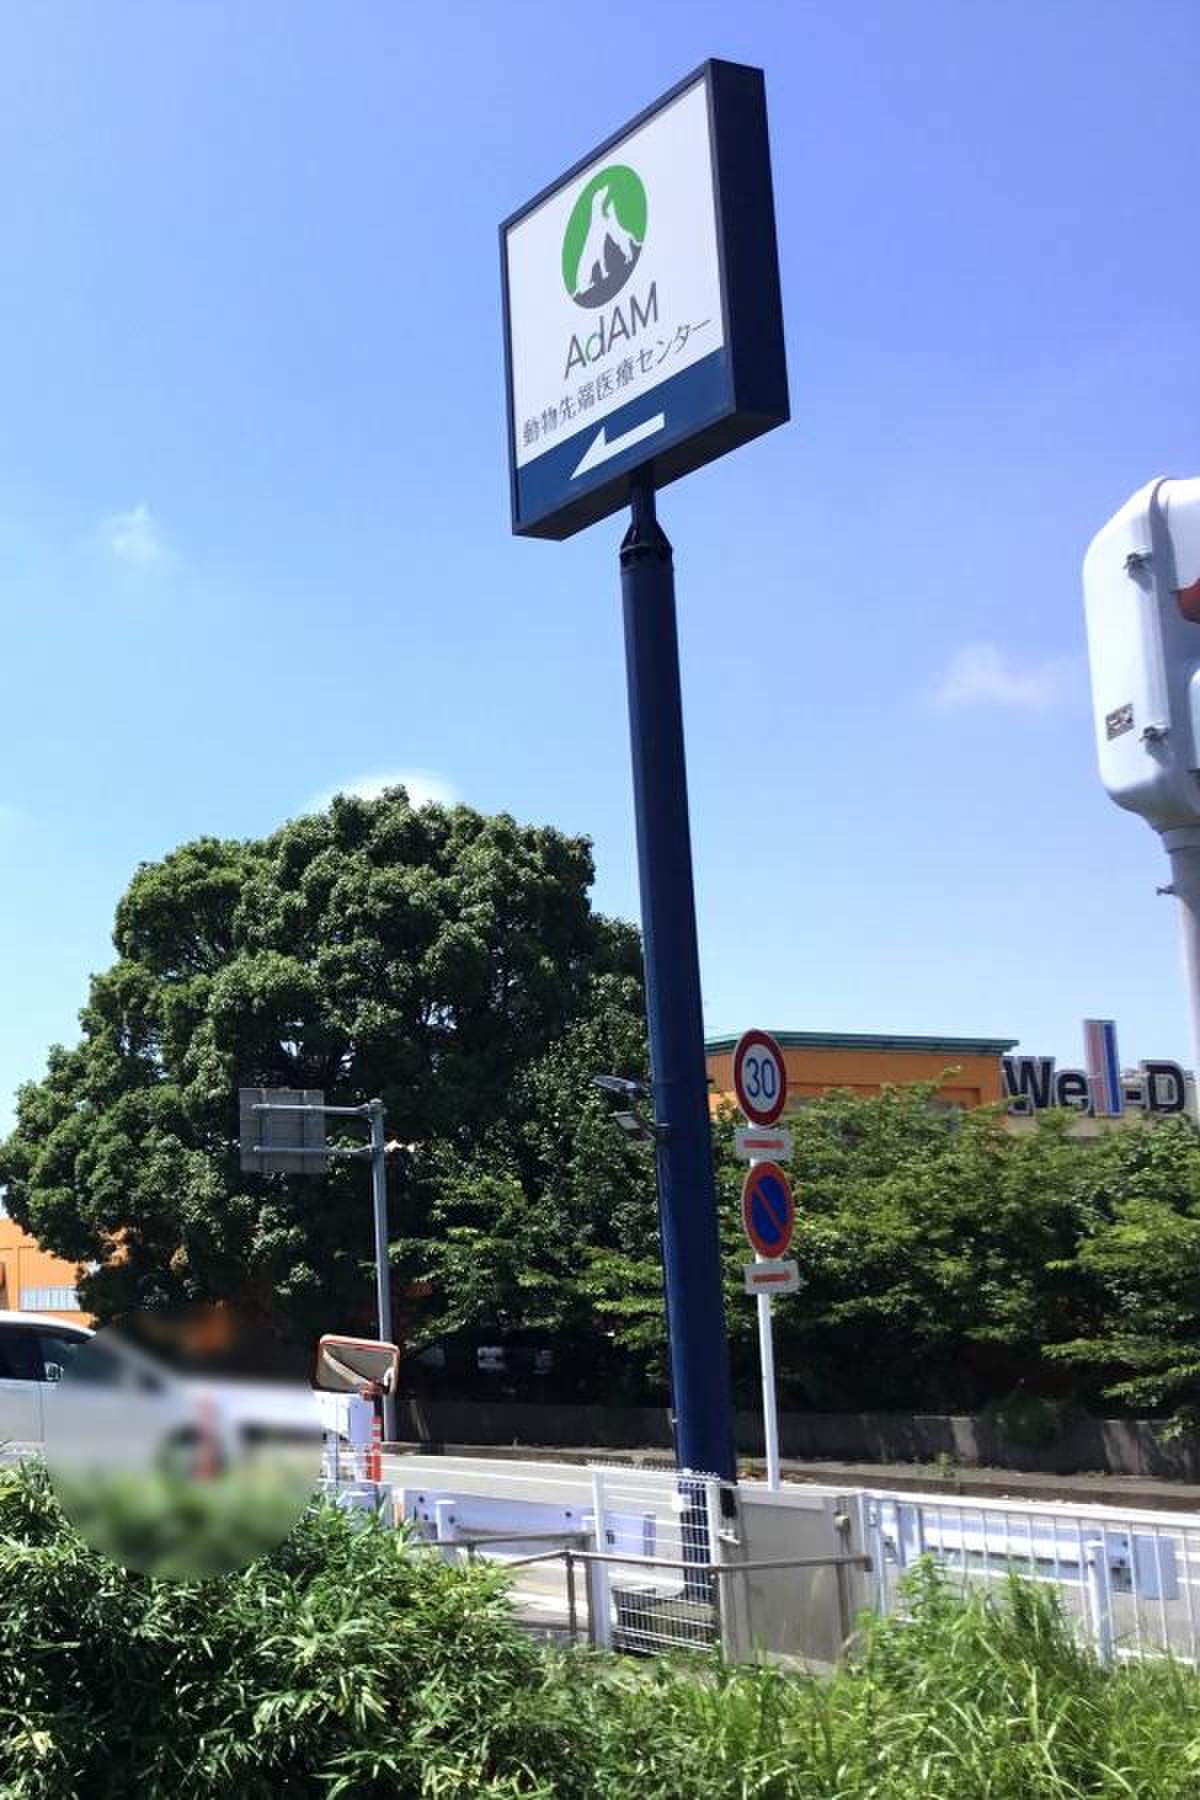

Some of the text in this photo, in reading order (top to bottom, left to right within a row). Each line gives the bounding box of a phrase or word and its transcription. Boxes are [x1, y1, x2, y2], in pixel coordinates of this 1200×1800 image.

[564, 280, 658, 379] AdAM
[522, 319, 711, 447] 動物先端医療センター
[745, 1057, 776, 1099] 30
